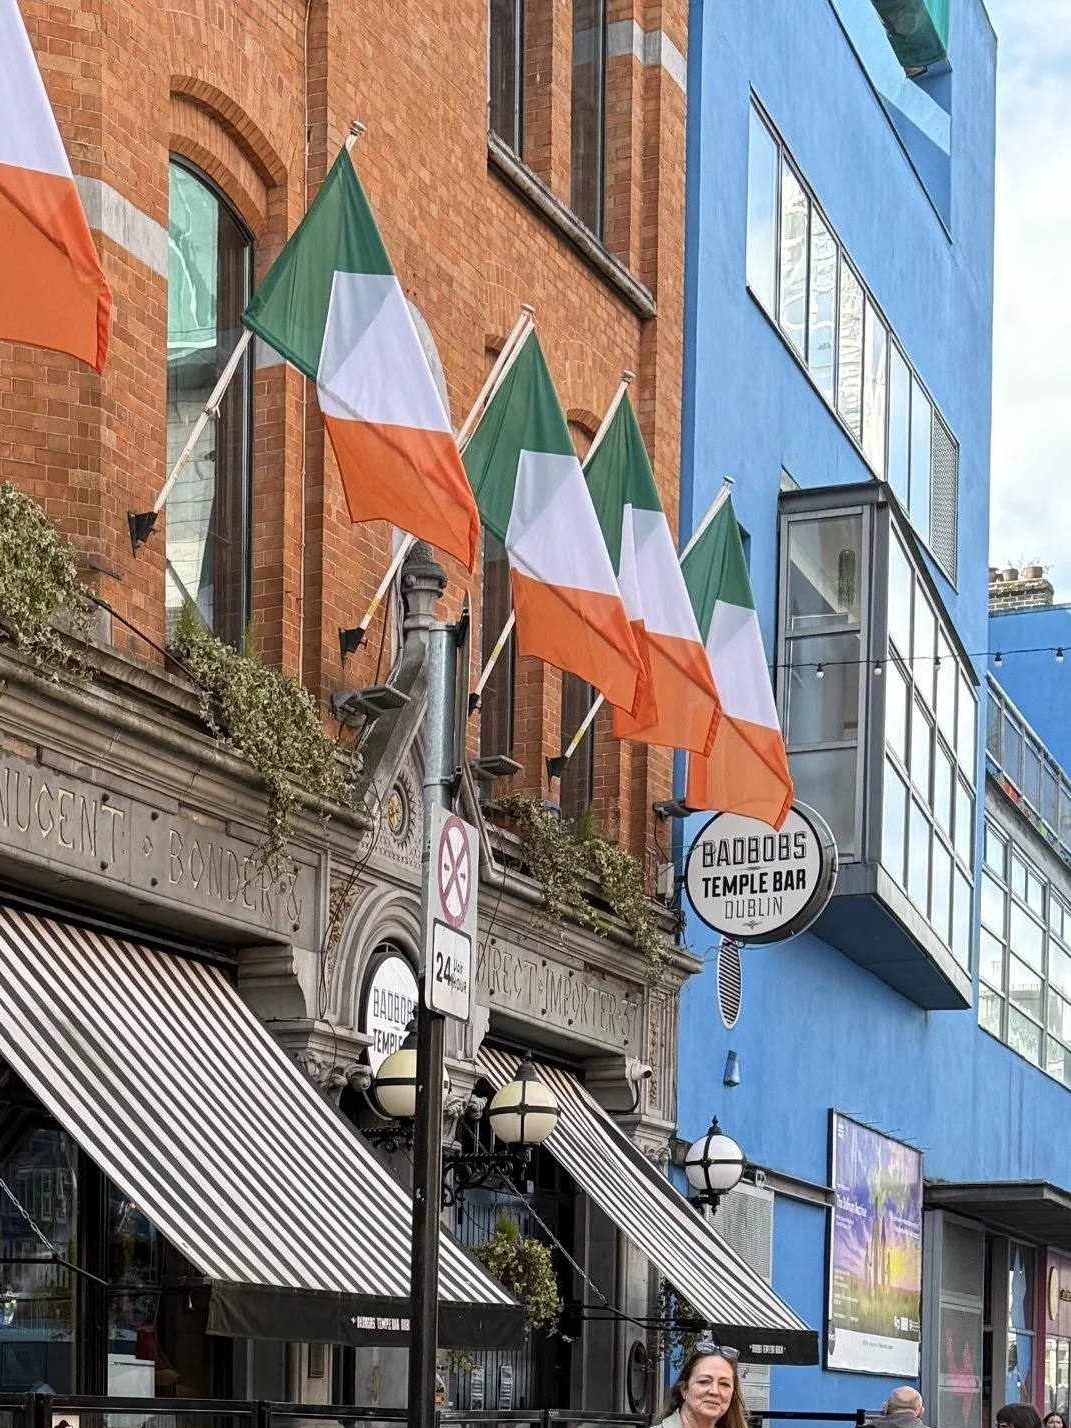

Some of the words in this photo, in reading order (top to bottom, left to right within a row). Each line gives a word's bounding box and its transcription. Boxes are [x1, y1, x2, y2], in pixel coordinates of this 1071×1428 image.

[702, 831, 807, 868] BADBOBS
[168, 828, 274, 916] BONDER
[702, 872, 768, 898] TEMPLE
[772, 869, 806, 893] BAR
[724, 896, 783, 919] DUBLIN
[436, 951, 451, 986] 24
